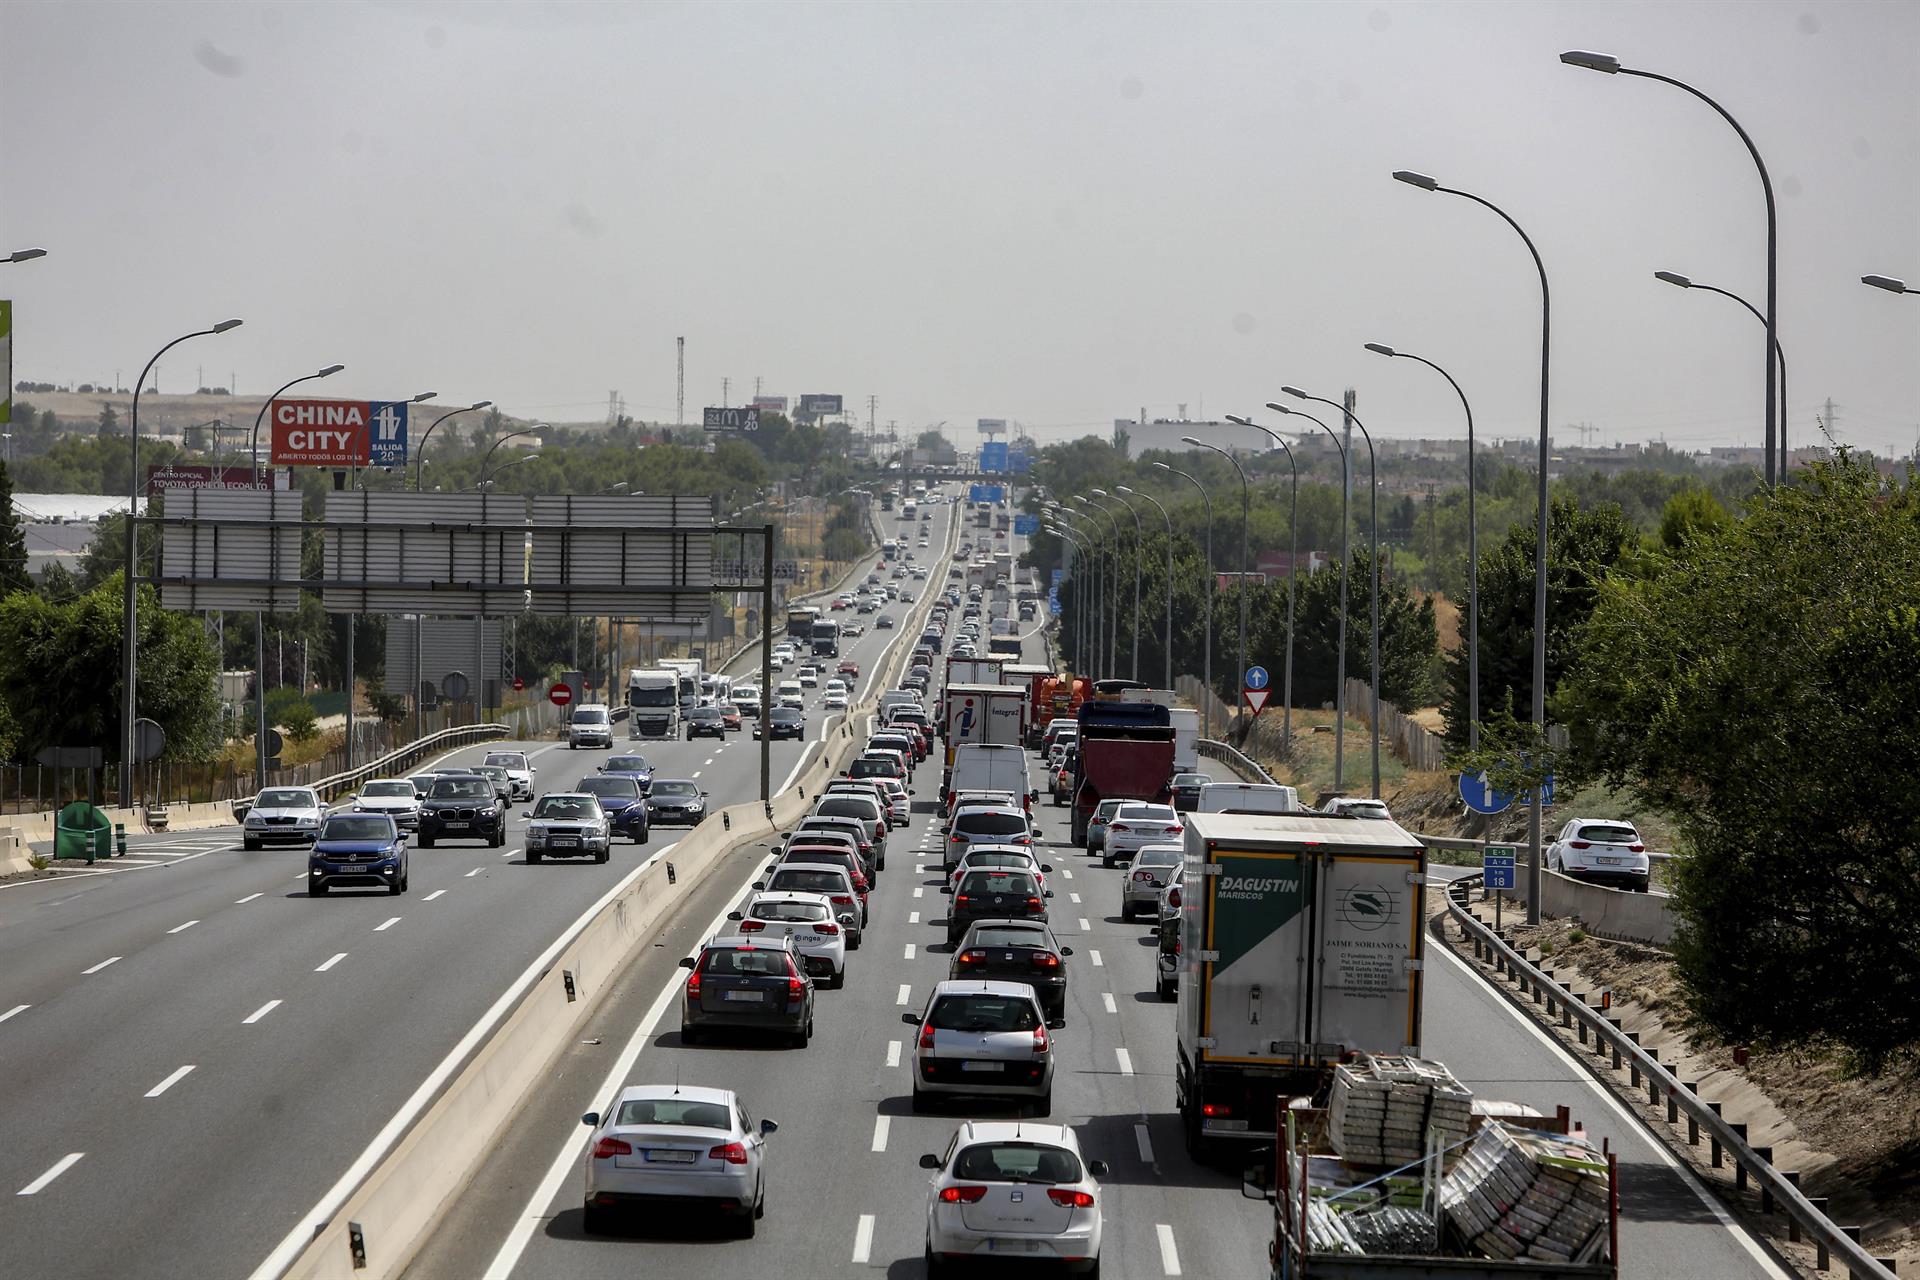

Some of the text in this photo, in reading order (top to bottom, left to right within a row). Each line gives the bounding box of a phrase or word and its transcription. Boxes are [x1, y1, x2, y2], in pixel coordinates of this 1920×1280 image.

[277, 405, 364, 426] CHINA
[744, 421, 759, 431] 20
[288, 431, 352, 450] CITY
[371, 444, 403, 452] SALIDA
[153, 480, 187, 489] TOYOTA
[1493, 877, 1505, 886] 18
[1218, 891, 1264, 900] MARISCOS
[1354, 941, 1394, 949] SORIANO
